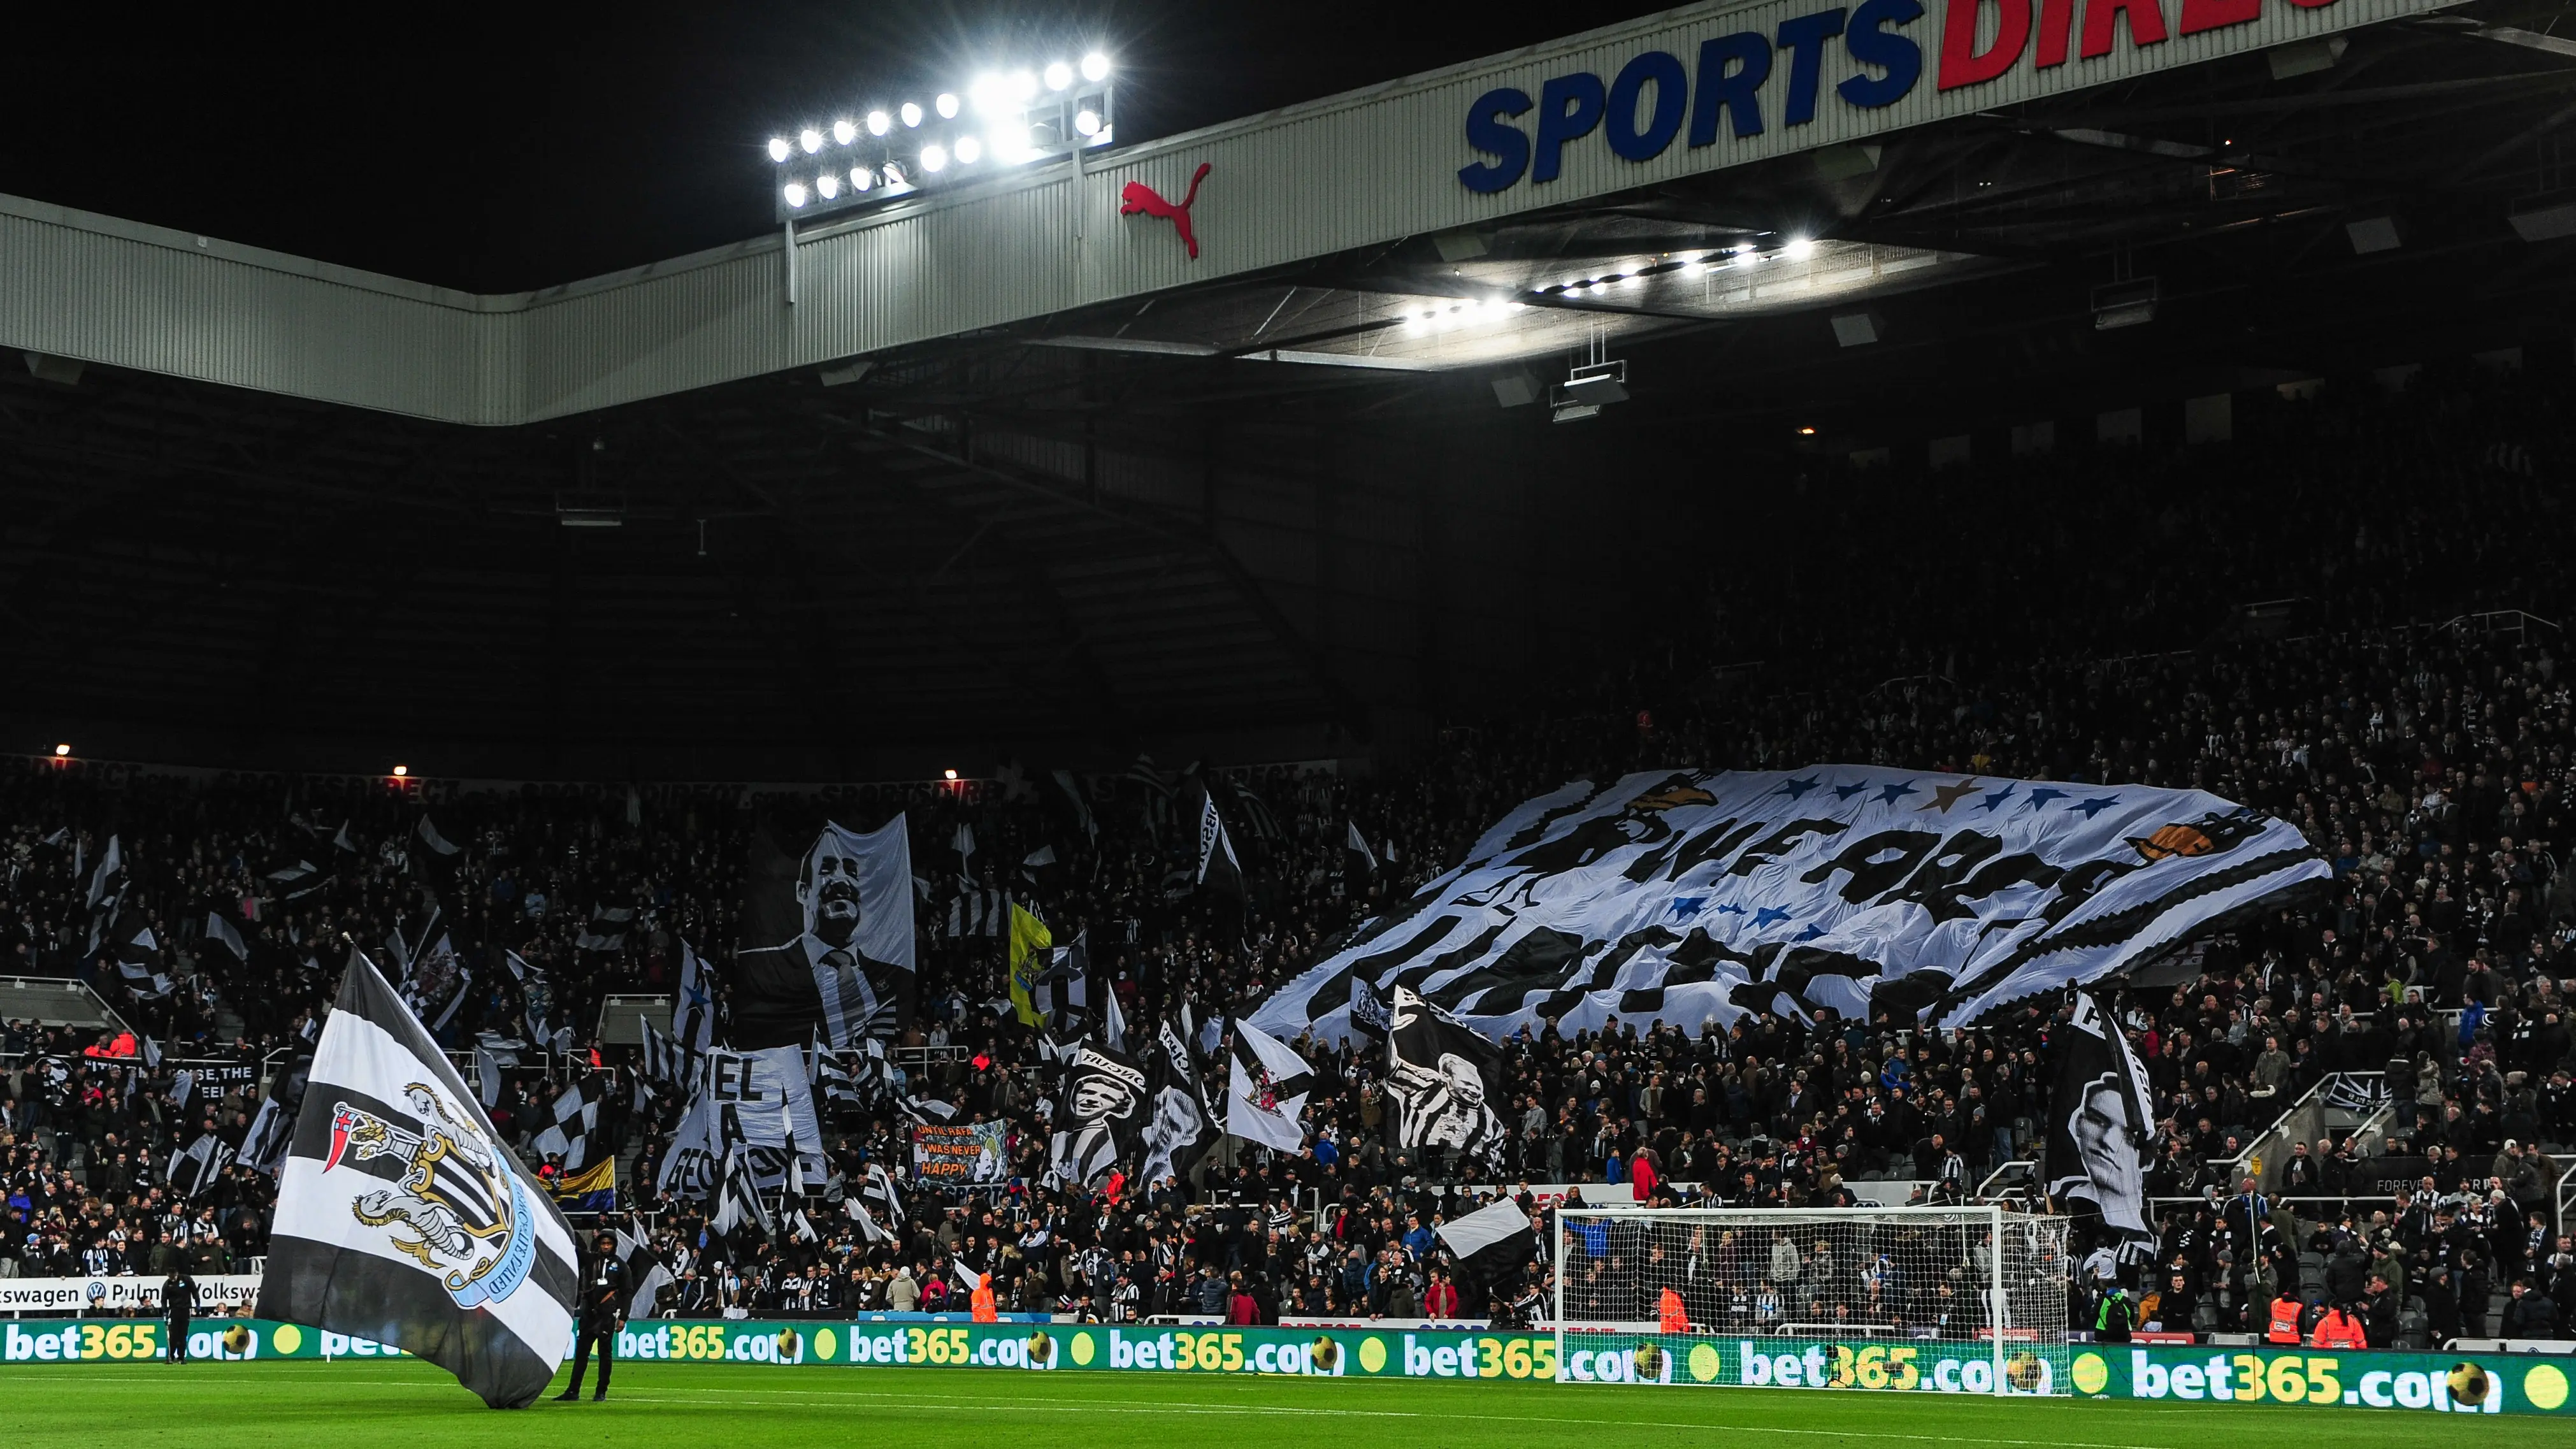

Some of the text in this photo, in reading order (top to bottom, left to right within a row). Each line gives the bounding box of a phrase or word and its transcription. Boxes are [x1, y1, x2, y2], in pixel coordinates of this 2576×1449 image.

[220, 1067, 252, 1080] THE
[917, 1125, 974, 1136] UNTIL RAFA
[921, 1143, 981, 1156] I WAS NEVER
[921, 1161, 968, 1176] HAPPY
[0, 1290, 78, 1307] swagen
[113, 1283, 159, 1301] Pulm
